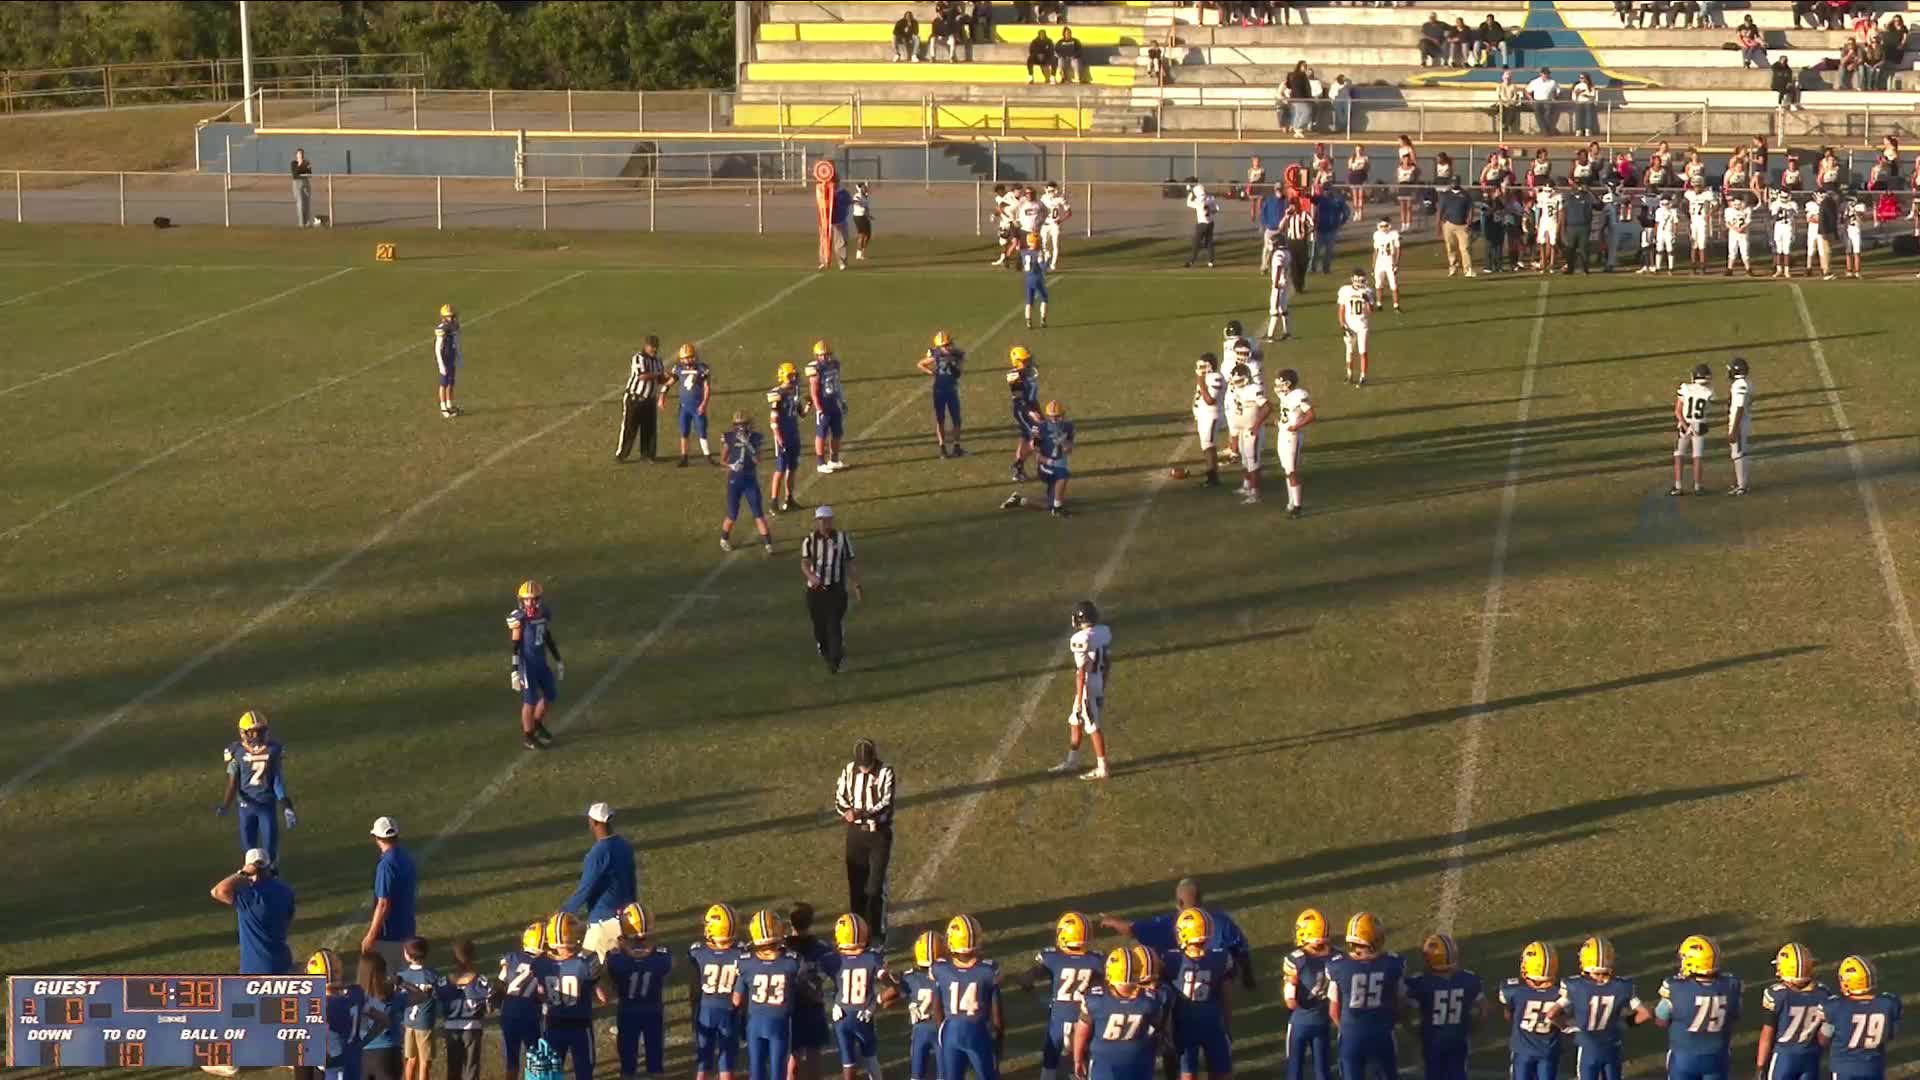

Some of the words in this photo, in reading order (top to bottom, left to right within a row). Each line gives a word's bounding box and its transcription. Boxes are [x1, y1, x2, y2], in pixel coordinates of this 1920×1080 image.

[1686, 396, 1706, 420] 19
[702, 963, 737, 994] 30
[751, 973, 785, 1004] 33
[841, 967, 867, 1005] 18
[1349, 971, 1384, 1008] 65
[949, 981, 978, 1016] 14
[1432, 988, 1465, 1026] 55
[1587, 995, 1616, 1032] 17
[1687, 995, 1728, 1033] 75
[1102, 1013, 1143, 1041] 67
[1847, 1013, 1885, 1049] 79
